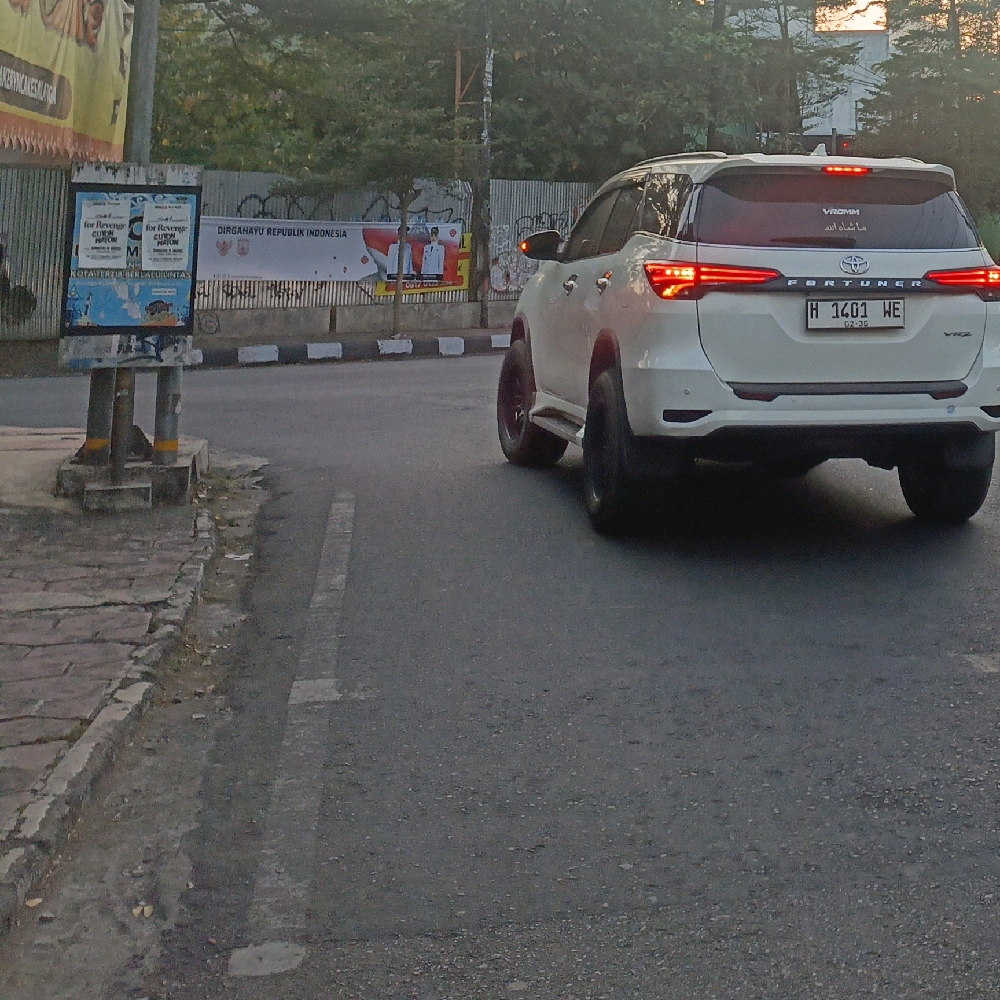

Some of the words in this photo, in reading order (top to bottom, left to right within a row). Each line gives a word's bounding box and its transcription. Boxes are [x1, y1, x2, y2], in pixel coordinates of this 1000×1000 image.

[822, 208, 860, 216] VROMM
[96, 220, 126, 231] Revenge
[157, 223, 188, 234] Revenge
[217, 226, 264, 236] DIRGAHAYU
[266, 227, 304, 237] REPUBLIK
[306, 229, 347, 238] INDONESIA
[70, 269, 95, 278] KOTA
[787, 279, 922, 287] FORTUNER
[810, 302, 819, 319] H
[831, 301, 868, 319] 1401
[883, 301, 901, 318] WE
